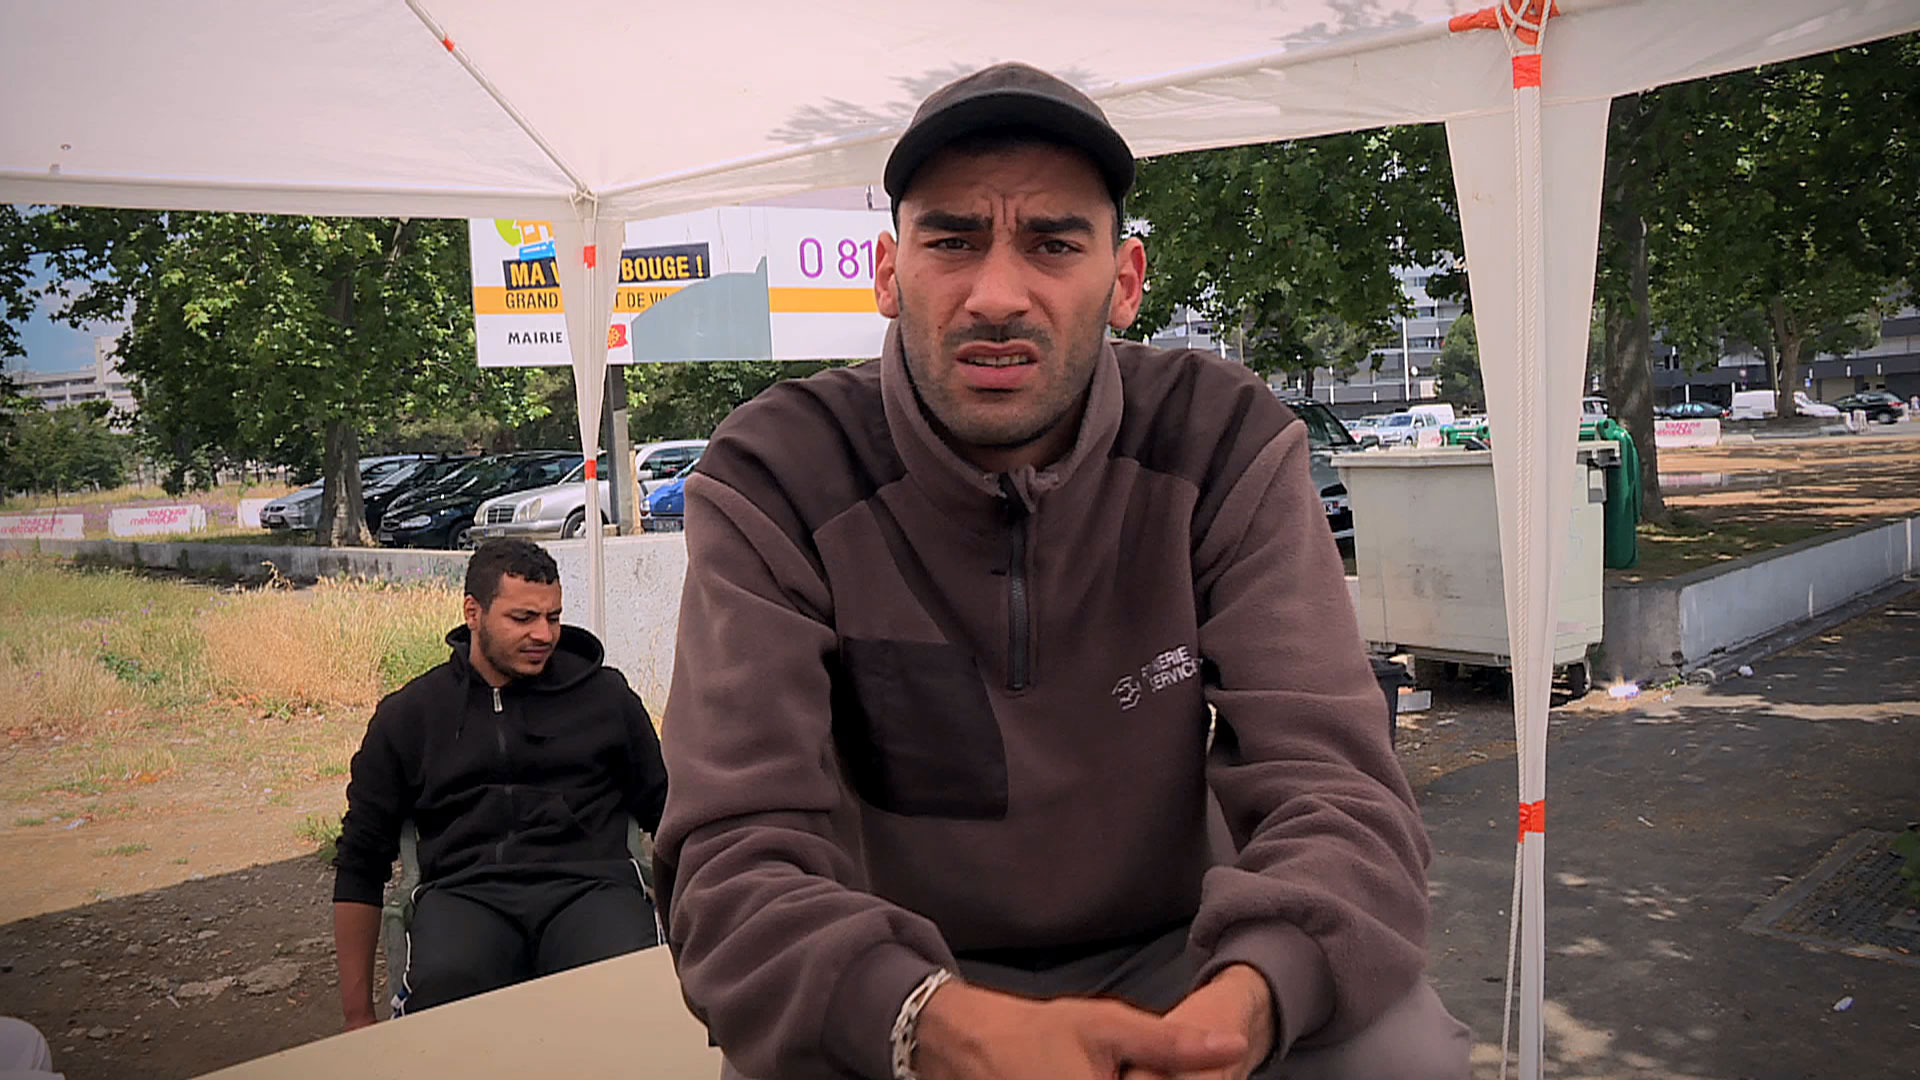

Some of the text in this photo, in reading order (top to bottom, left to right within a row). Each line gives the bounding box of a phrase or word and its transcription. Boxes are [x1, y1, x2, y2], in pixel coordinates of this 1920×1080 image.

[837, 238, 874, 279] 81
[510, 261, 547, 288] MA
[621, 256, 691, 281] BOUGE
[505, 292, 559, 310] GRAND
[627, 291, 646, 308] DE
[508, 331, 563, 345] MAIRIE
